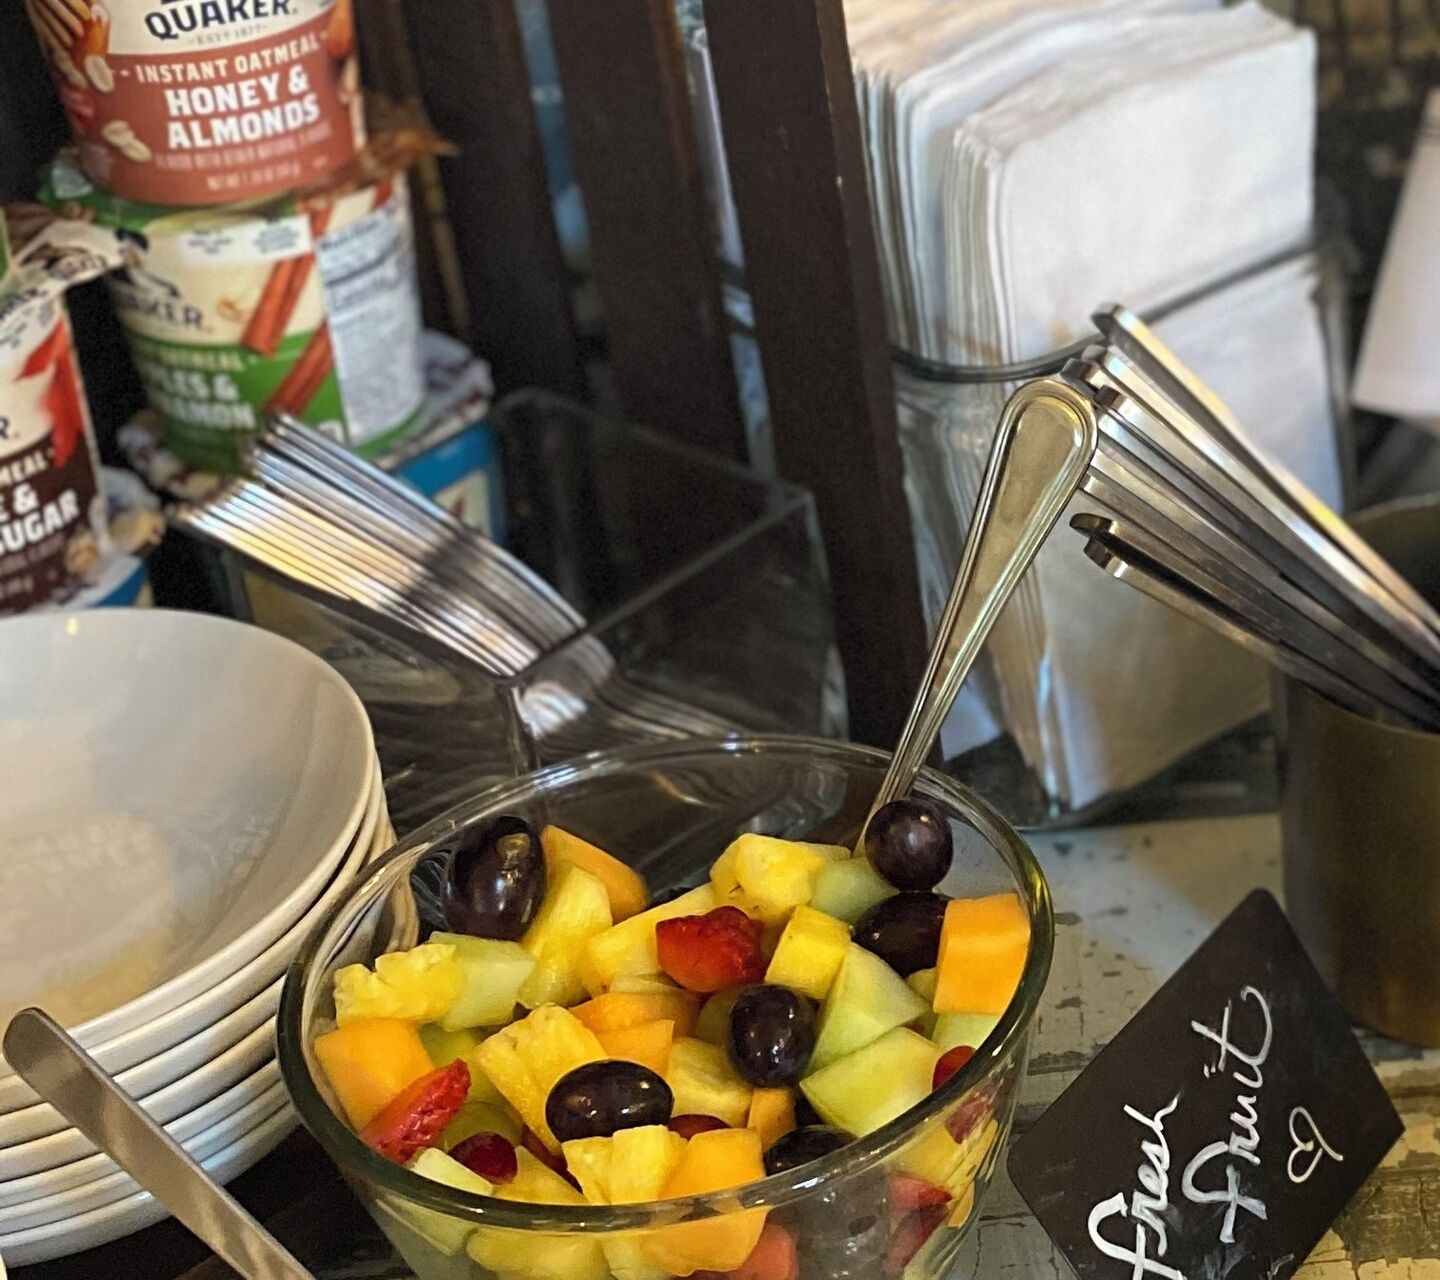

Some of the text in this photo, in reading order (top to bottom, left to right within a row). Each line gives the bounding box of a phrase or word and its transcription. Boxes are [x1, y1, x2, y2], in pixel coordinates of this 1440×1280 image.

[136, 33, 320, 84] INSTANT OATMEAL
[163, 63, 310, 118] HONEY &
[167, 93, 321, 150] ALMONDS
[13, 482, 38, 515] &
[1181, 985, 1273, 1244] fruit
